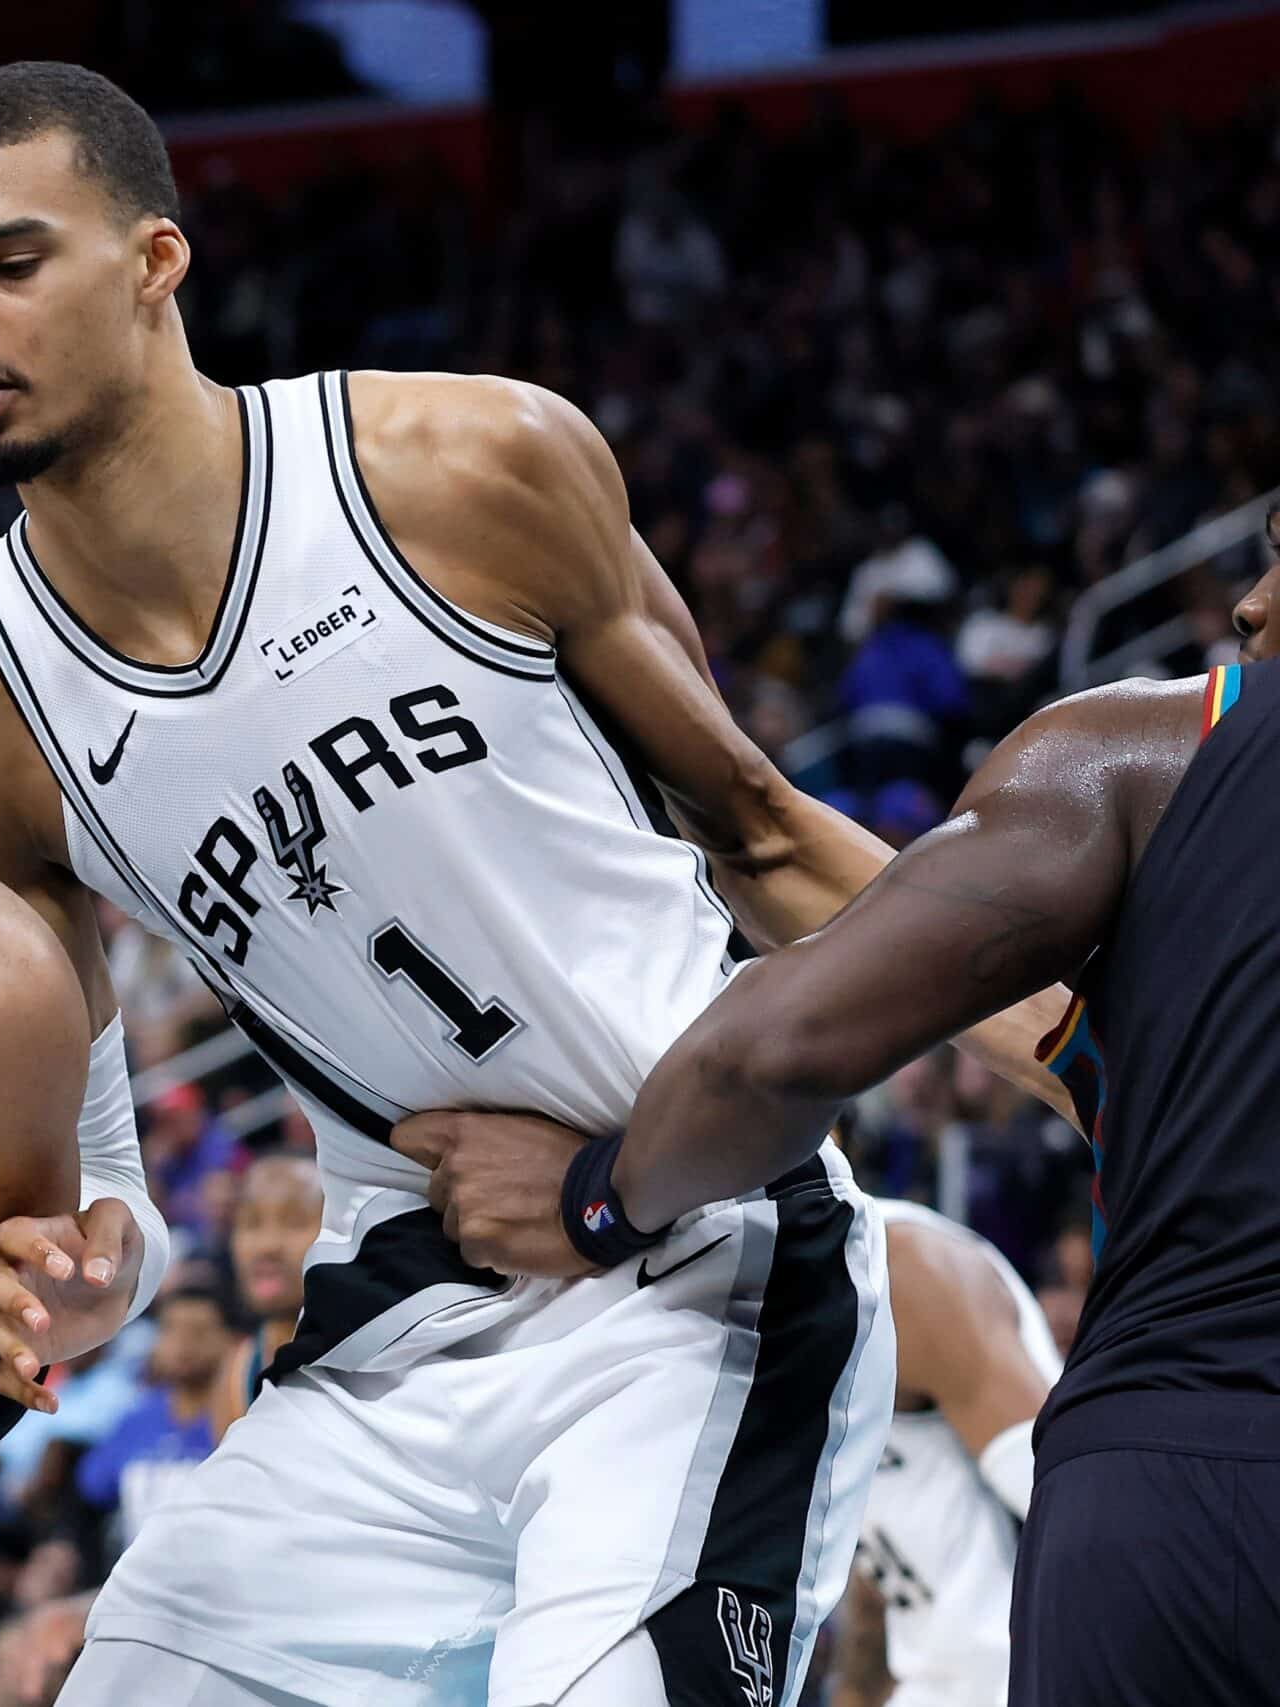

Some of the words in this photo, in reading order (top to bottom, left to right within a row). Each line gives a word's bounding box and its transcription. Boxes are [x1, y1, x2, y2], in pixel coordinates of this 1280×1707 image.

[278, 603, 358, 664] LEDGER
[177, 684, 488, 967] SPURS
[367, 917, 527, 1065] 1
